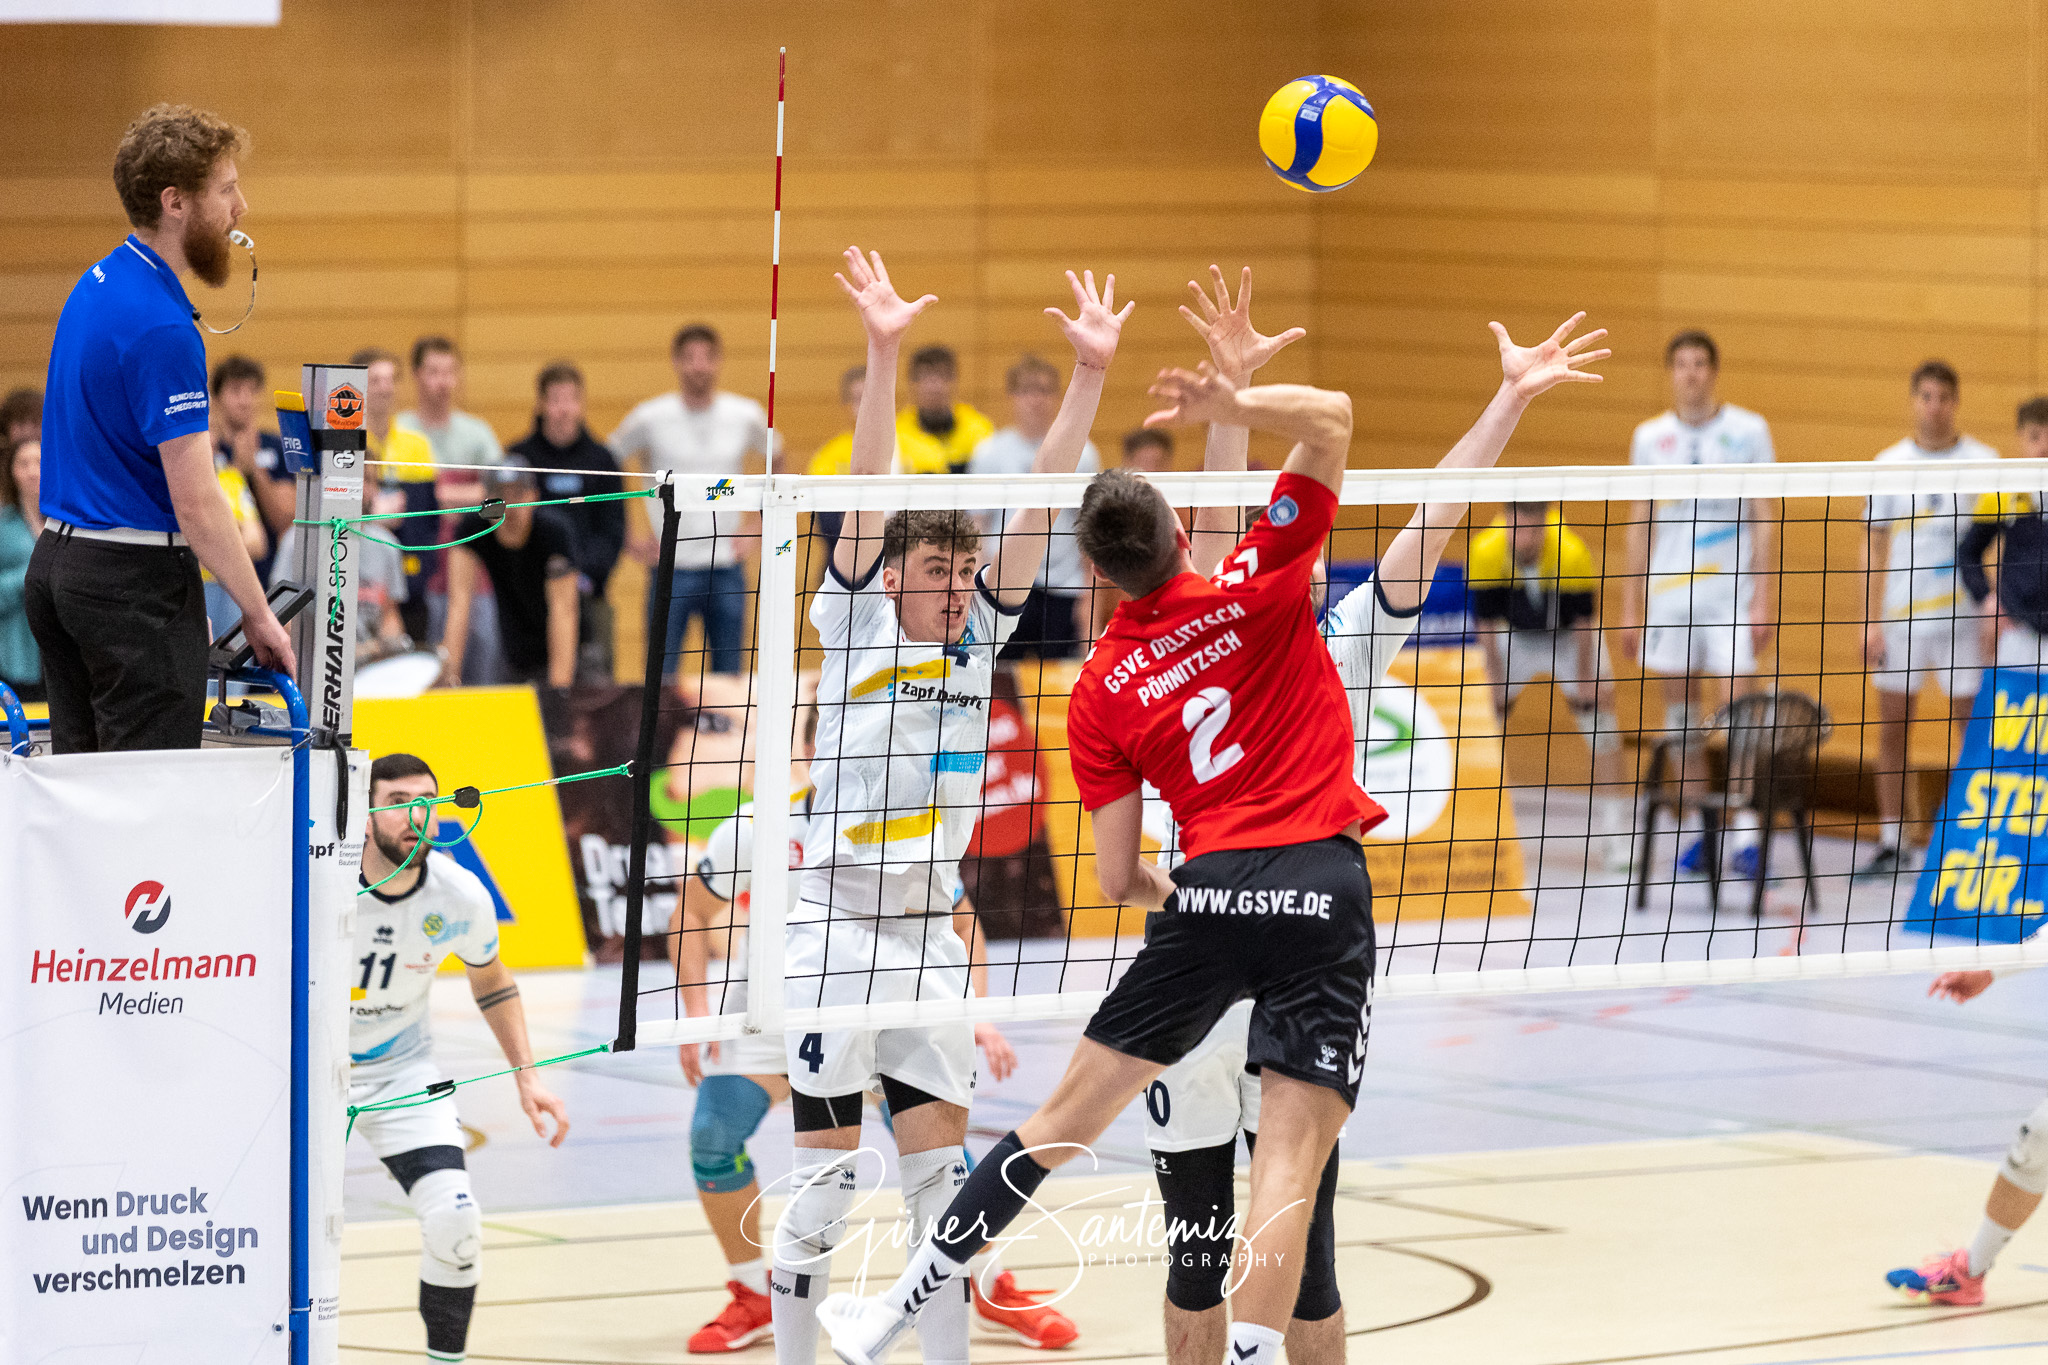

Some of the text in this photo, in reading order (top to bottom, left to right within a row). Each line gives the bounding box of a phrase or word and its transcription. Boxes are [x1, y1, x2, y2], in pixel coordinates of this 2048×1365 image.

[283, 437, 303, 450] FIVB
[705, 486, 735, 496] HUCK
[322, 515, 349, 732] ERHARD SPOR
[1104, 602, 1246, 694] GSVE DELITZSCH
[1137, 629, 1243, 707] PÖHNITZSCH
[901, 681, 936, 700] Zapf
[1182, 686, 1245, 784] 2
[308, 842, 335, 859] apf
[1175, 887, 1333, 920] WWW.GSVE.DE
[31, 947, 257, 984] Heinzelmann
[359, 952, 397, 989] 11
[98, 991, 184, 1015] Medien
[798, 1032, 825, 1074] 4
[1144, 1080, 1171, 1127] 0
[22, 1186, 208, 1221] Wenn Druck
[82, 1220, 259, 1258] und Design
[33, 1260, 246, 1293] verschmelzen
